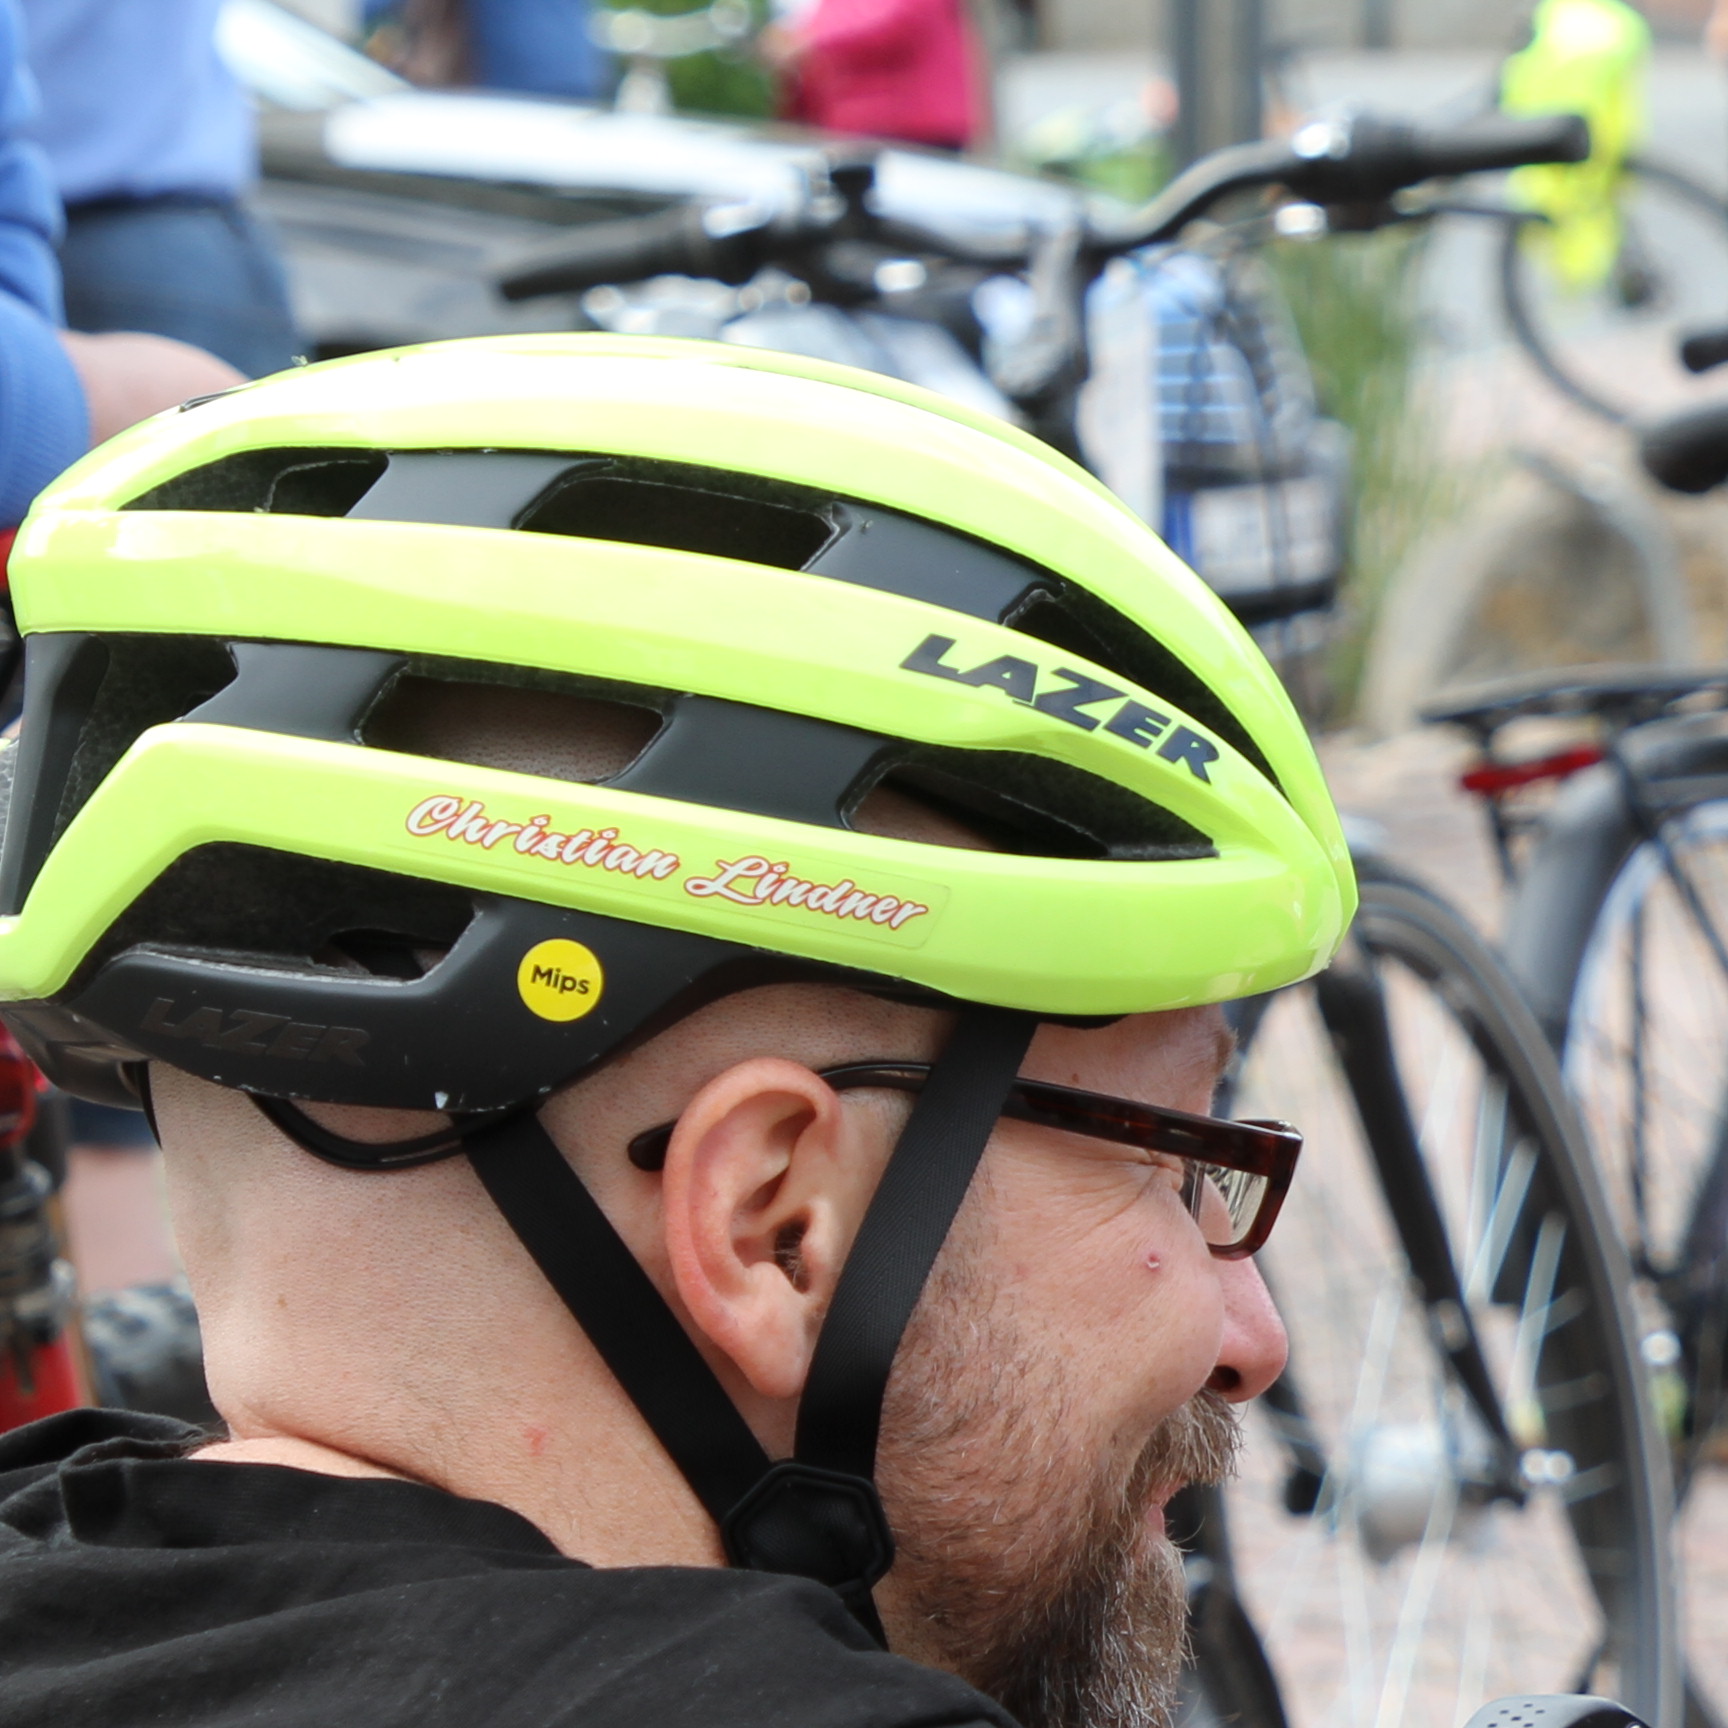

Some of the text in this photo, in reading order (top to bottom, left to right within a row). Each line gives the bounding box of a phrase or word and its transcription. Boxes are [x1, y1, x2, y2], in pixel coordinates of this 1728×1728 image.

[899, 632, 1221, 786] LAZER
[406, 795, 929, 930] Christian Lindner
[529, 963, 591, 995] Mips
[139, 996, 371, 1067] LAZER
